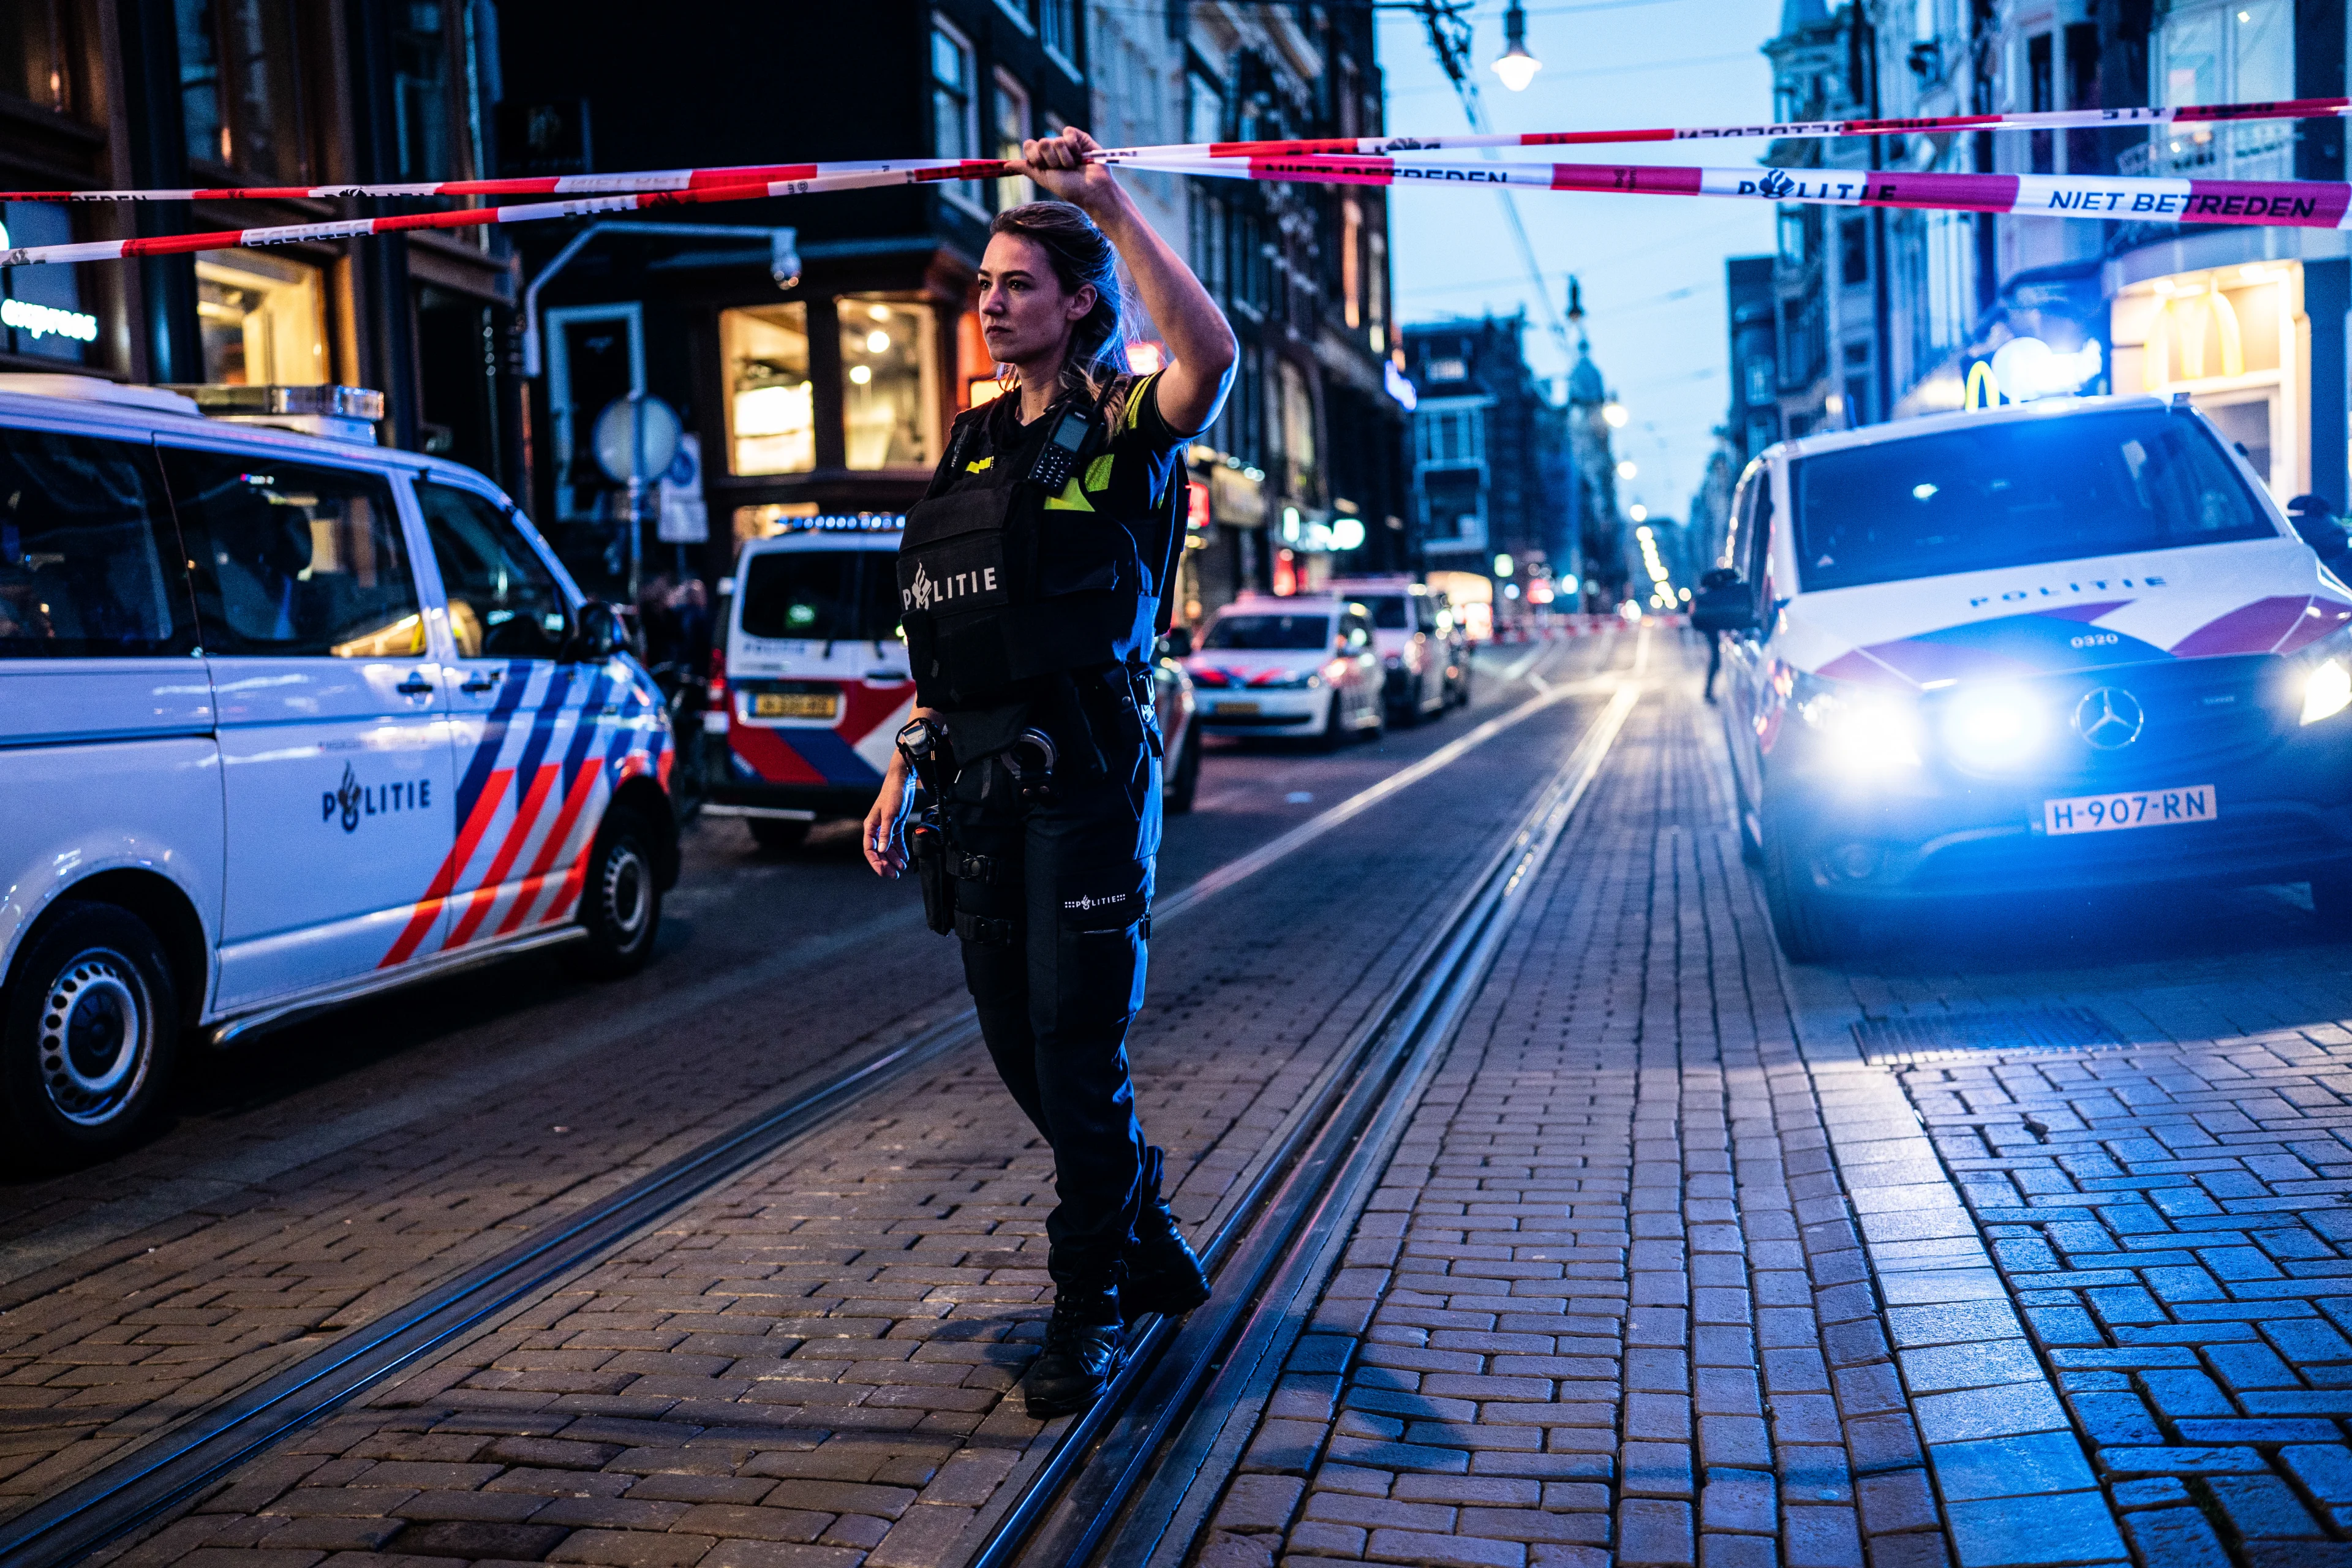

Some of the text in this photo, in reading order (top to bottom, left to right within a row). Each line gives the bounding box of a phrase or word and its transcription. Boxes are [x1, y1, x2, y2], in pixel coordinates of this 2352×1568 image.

[2048, 190, 2317, 219] NIET BETREDEN
[1969, 575, 2167, 608] POLITIE
[2070, 633, 2119, 649] 0320
[2053, 790, 2207, 829] H-907-RN
